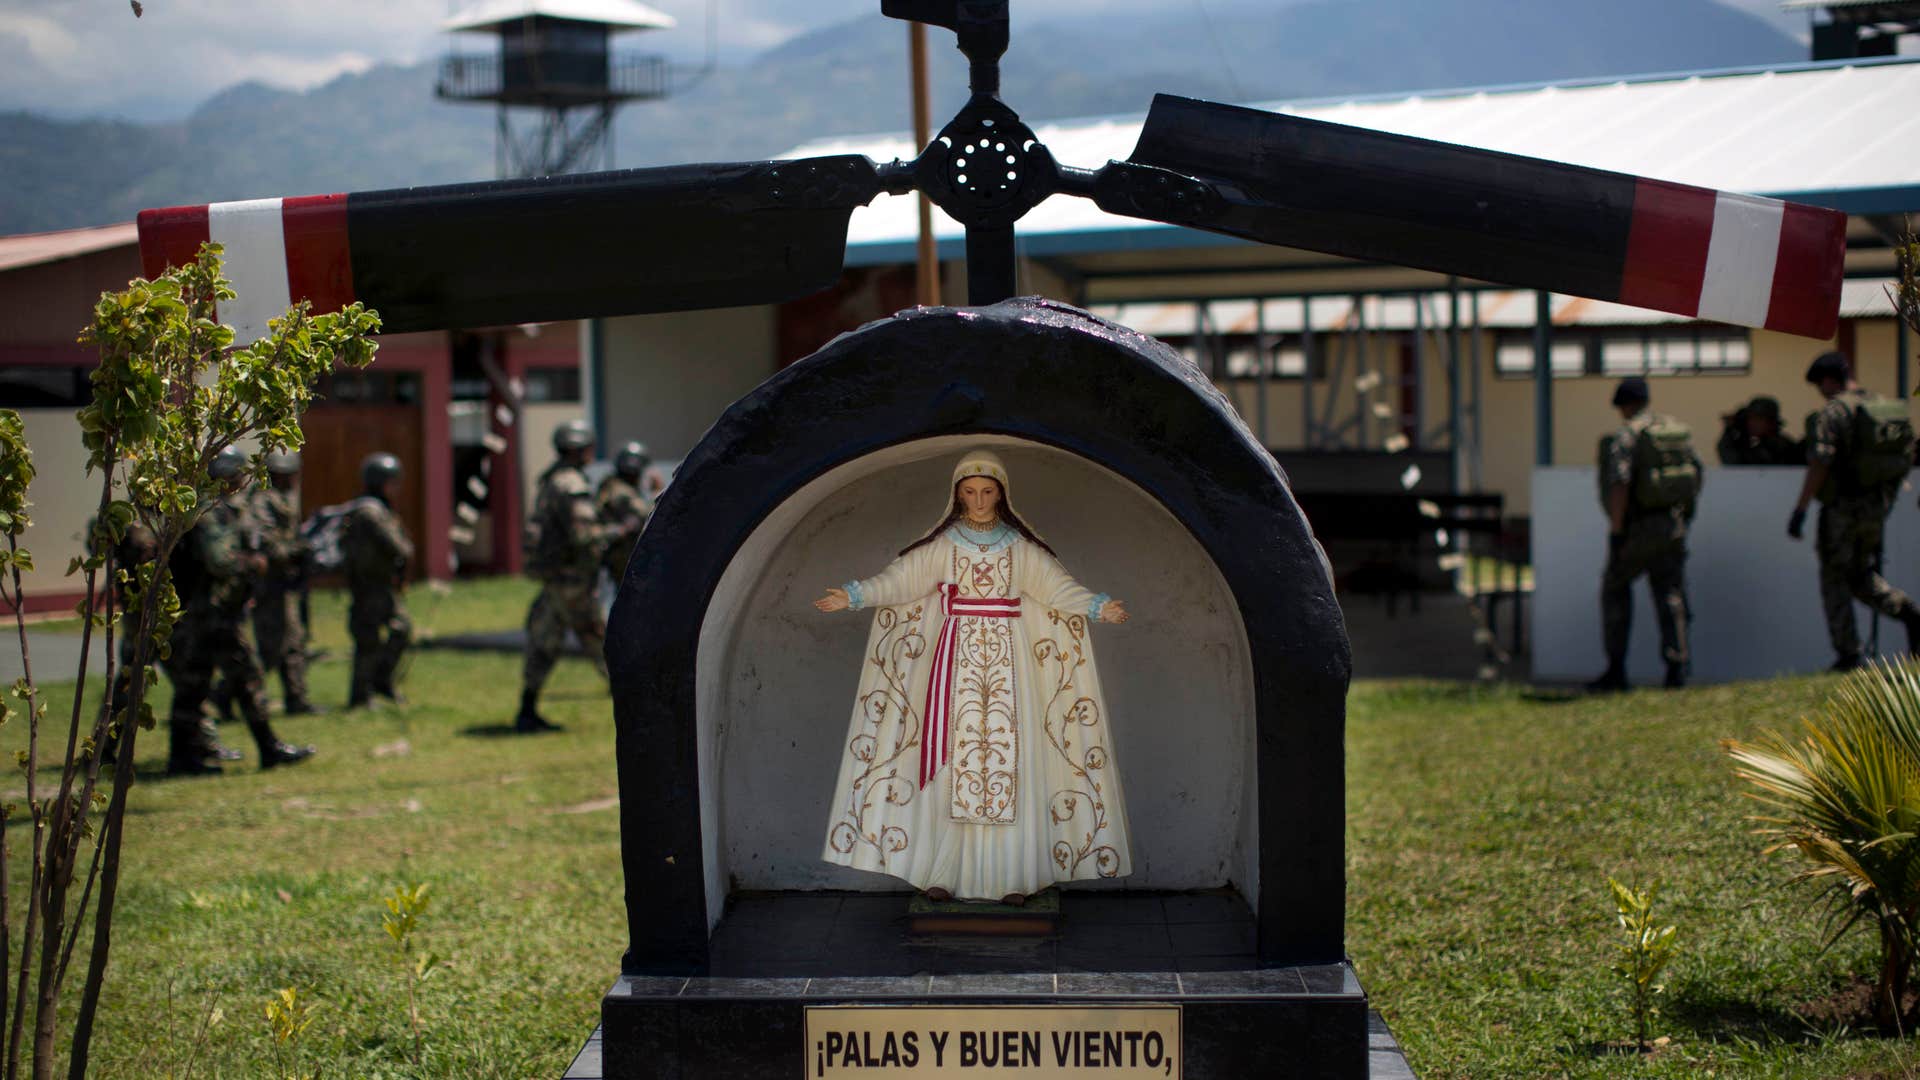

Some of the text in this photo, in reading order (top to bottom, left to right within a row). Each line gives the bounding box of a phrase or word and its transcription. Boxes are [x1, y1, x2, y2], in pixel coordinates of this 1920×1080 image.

[816, 1031, 1173, 1076] ¡PALAS Y BUEN VIENTO,
